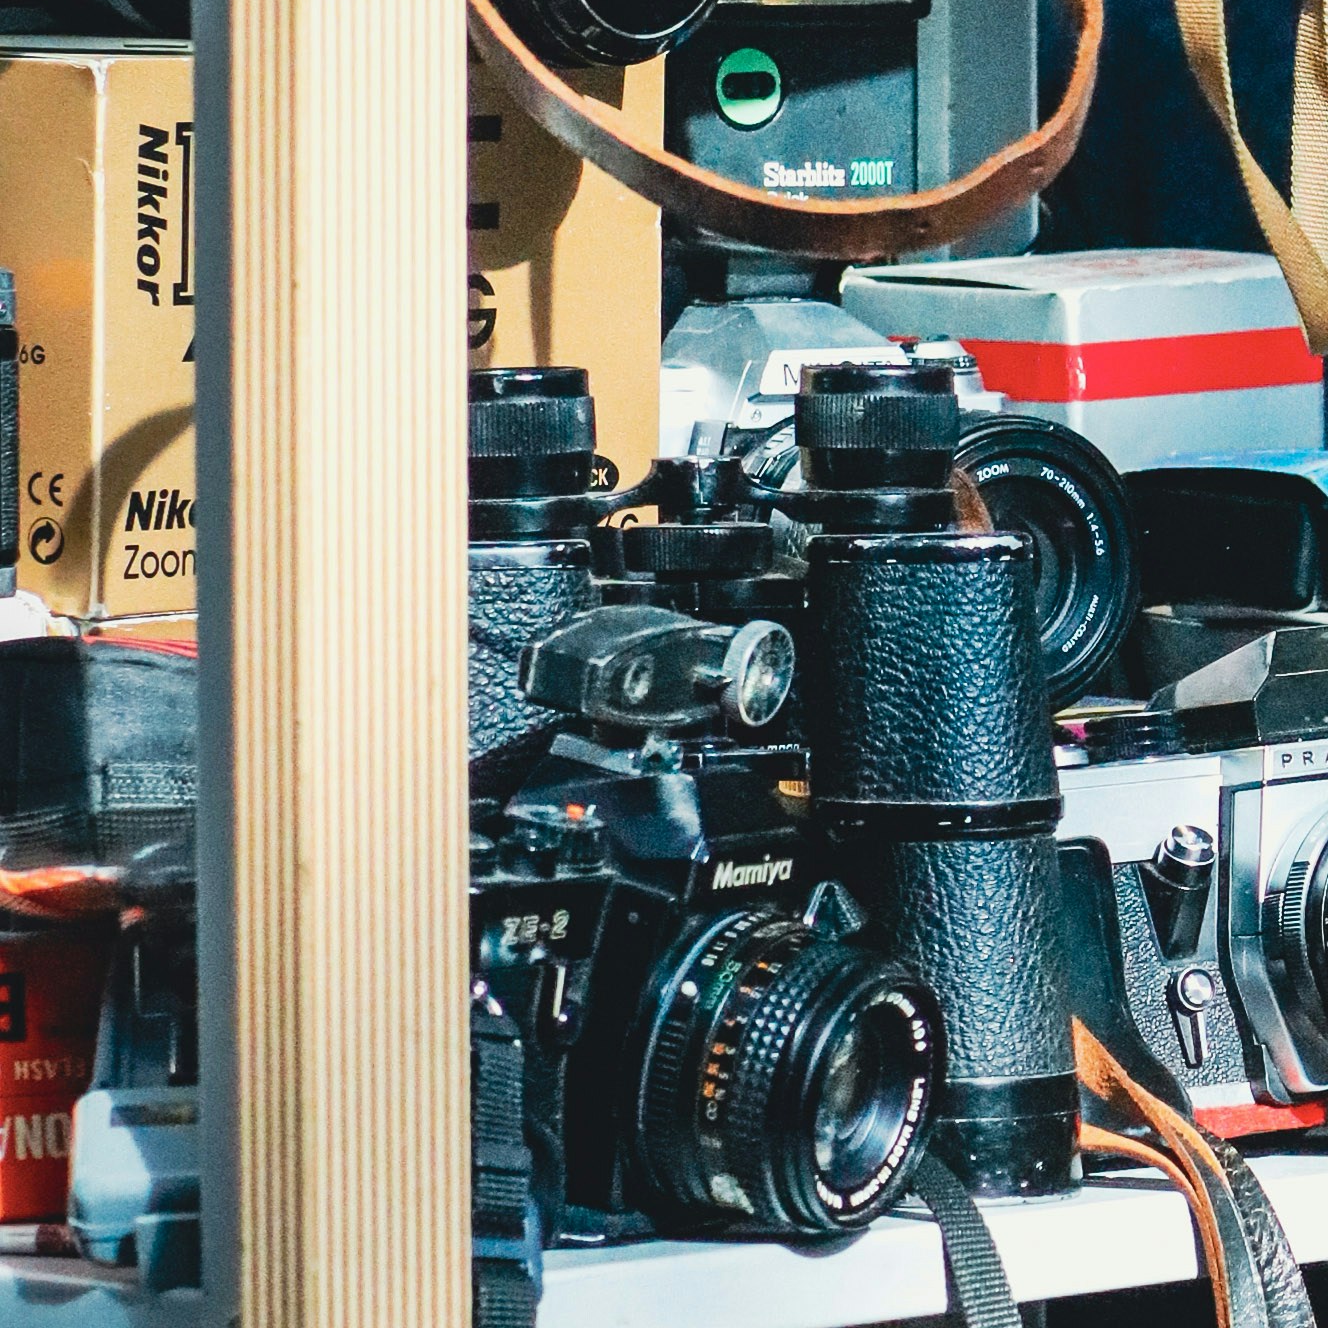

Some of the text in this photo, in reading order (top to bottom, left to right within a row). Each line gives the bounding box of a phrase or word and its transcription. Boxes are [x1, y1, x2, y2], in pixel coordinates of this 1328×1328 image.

[763, 161, 894, 187] Starblitz 2000T
[136, 124, 170, 307] Nikkor
[976, 463, 1010, 482] ZOOM
[1040, 467, 1086, 509] 70-210mm
[125, 489, 196, 531] Nik
[712, 854, 793, 890] Mamiya
